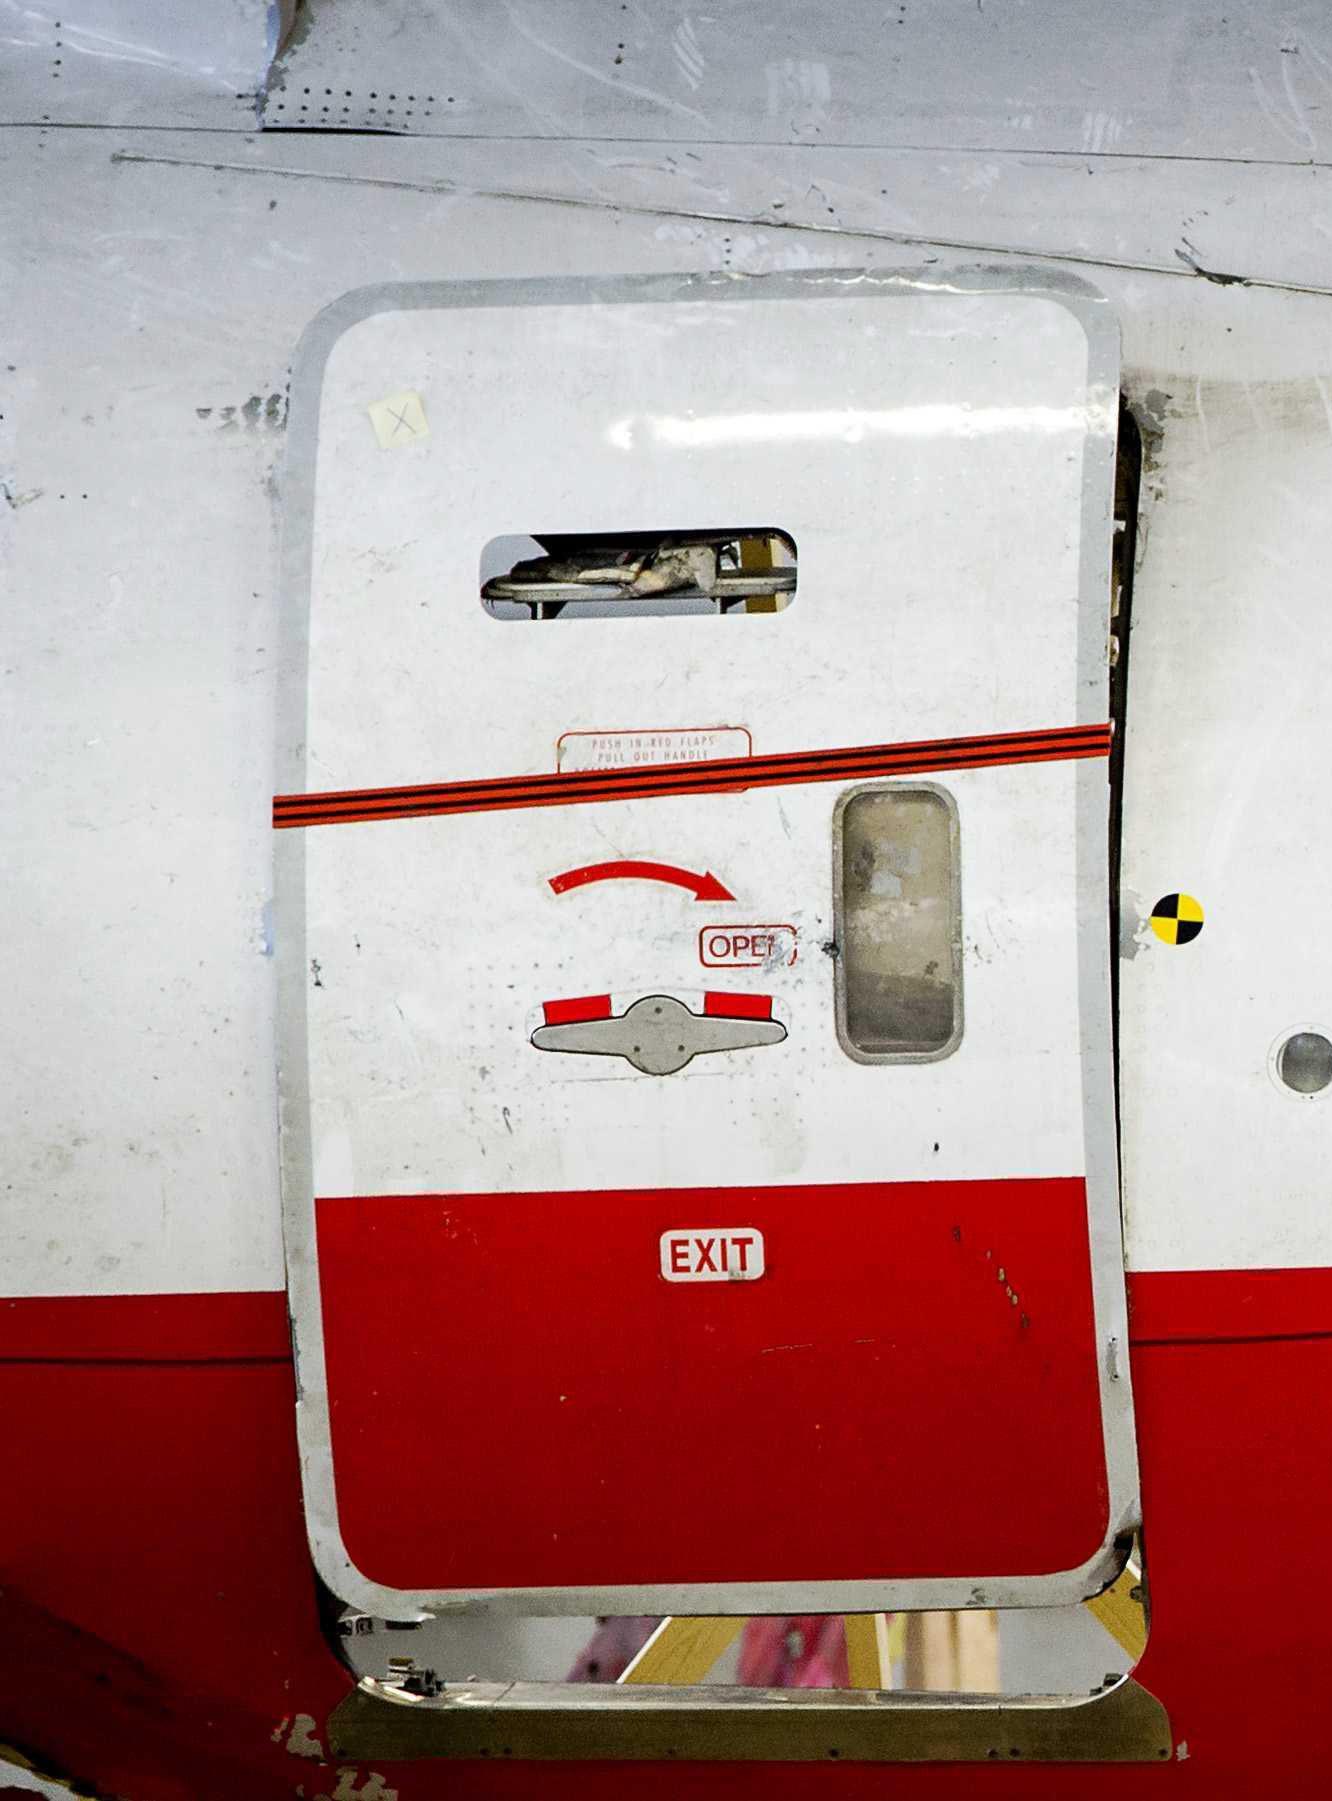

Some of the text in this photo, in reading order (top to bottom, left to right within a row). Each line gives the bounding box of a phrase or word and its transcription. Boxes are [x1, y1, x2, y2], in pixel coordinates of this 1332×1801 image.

[592, 736, 714, 750] PUSH IN RED FLAPS
[598, 750, 708, 762] PULL OUT HANDLE
[670, 1237, 754, 1273] EXIT
